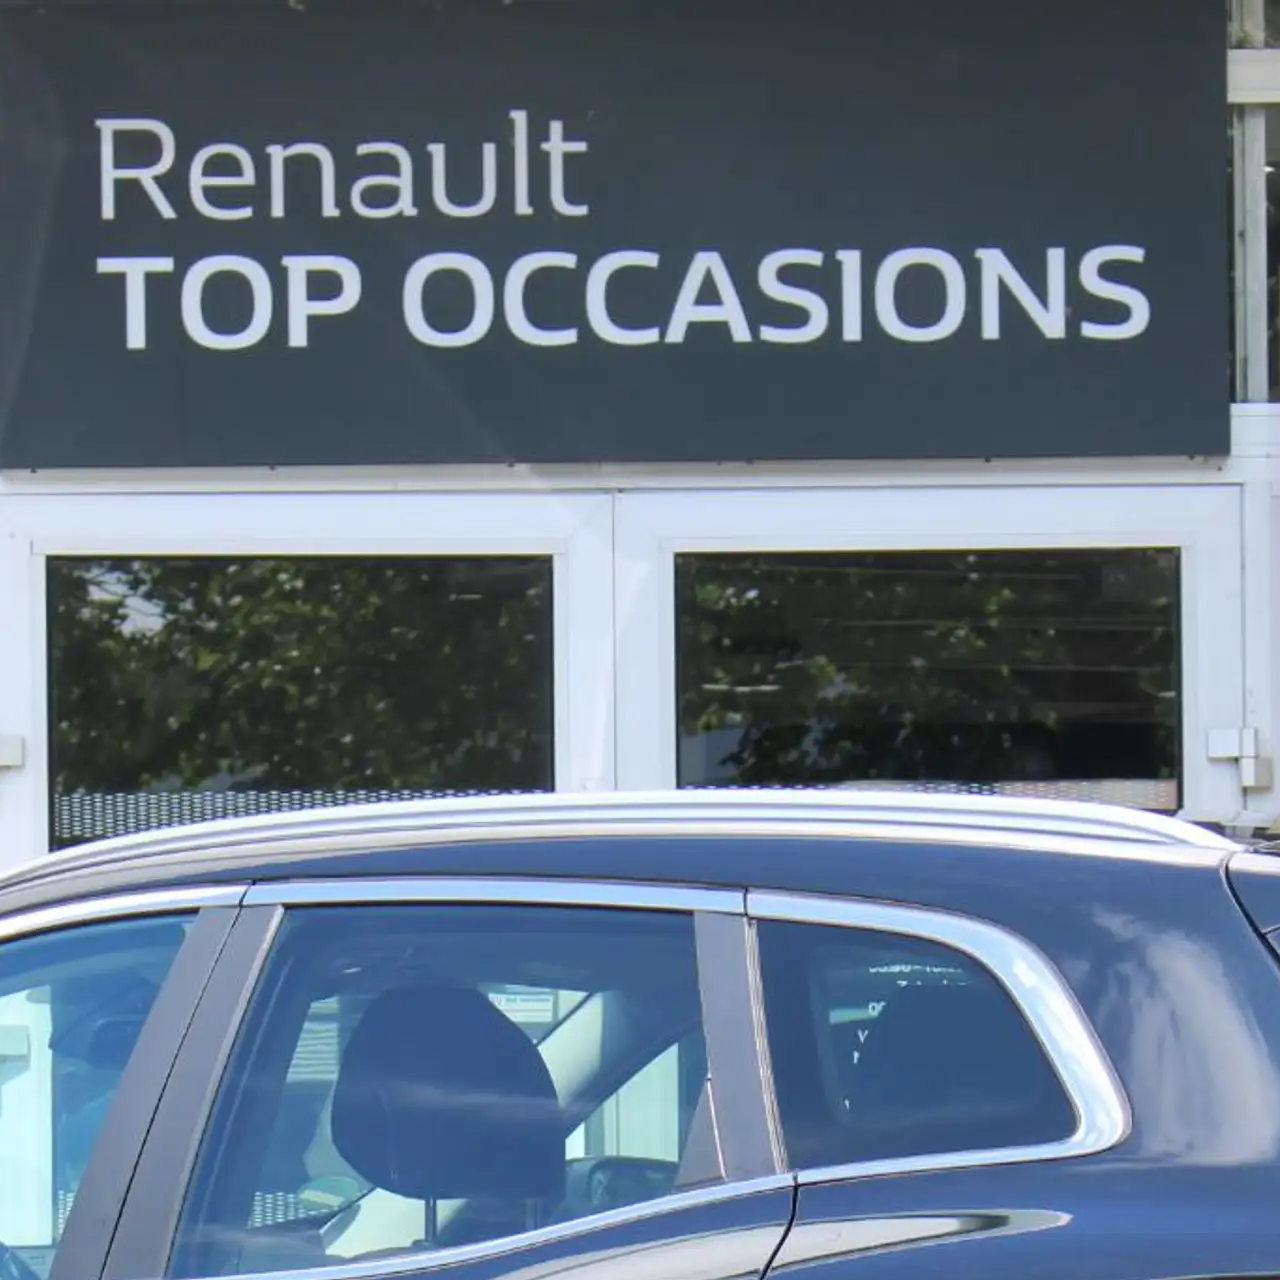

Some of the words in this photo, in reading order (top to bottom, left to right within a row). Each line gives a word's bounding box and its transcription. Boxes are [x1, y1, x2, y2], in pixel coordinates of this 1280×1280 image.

[95, 110, 588, 220] Renault
[96, 254, 362, 350] TOP
[402, 245, 1151, 348] OCCASIONS
